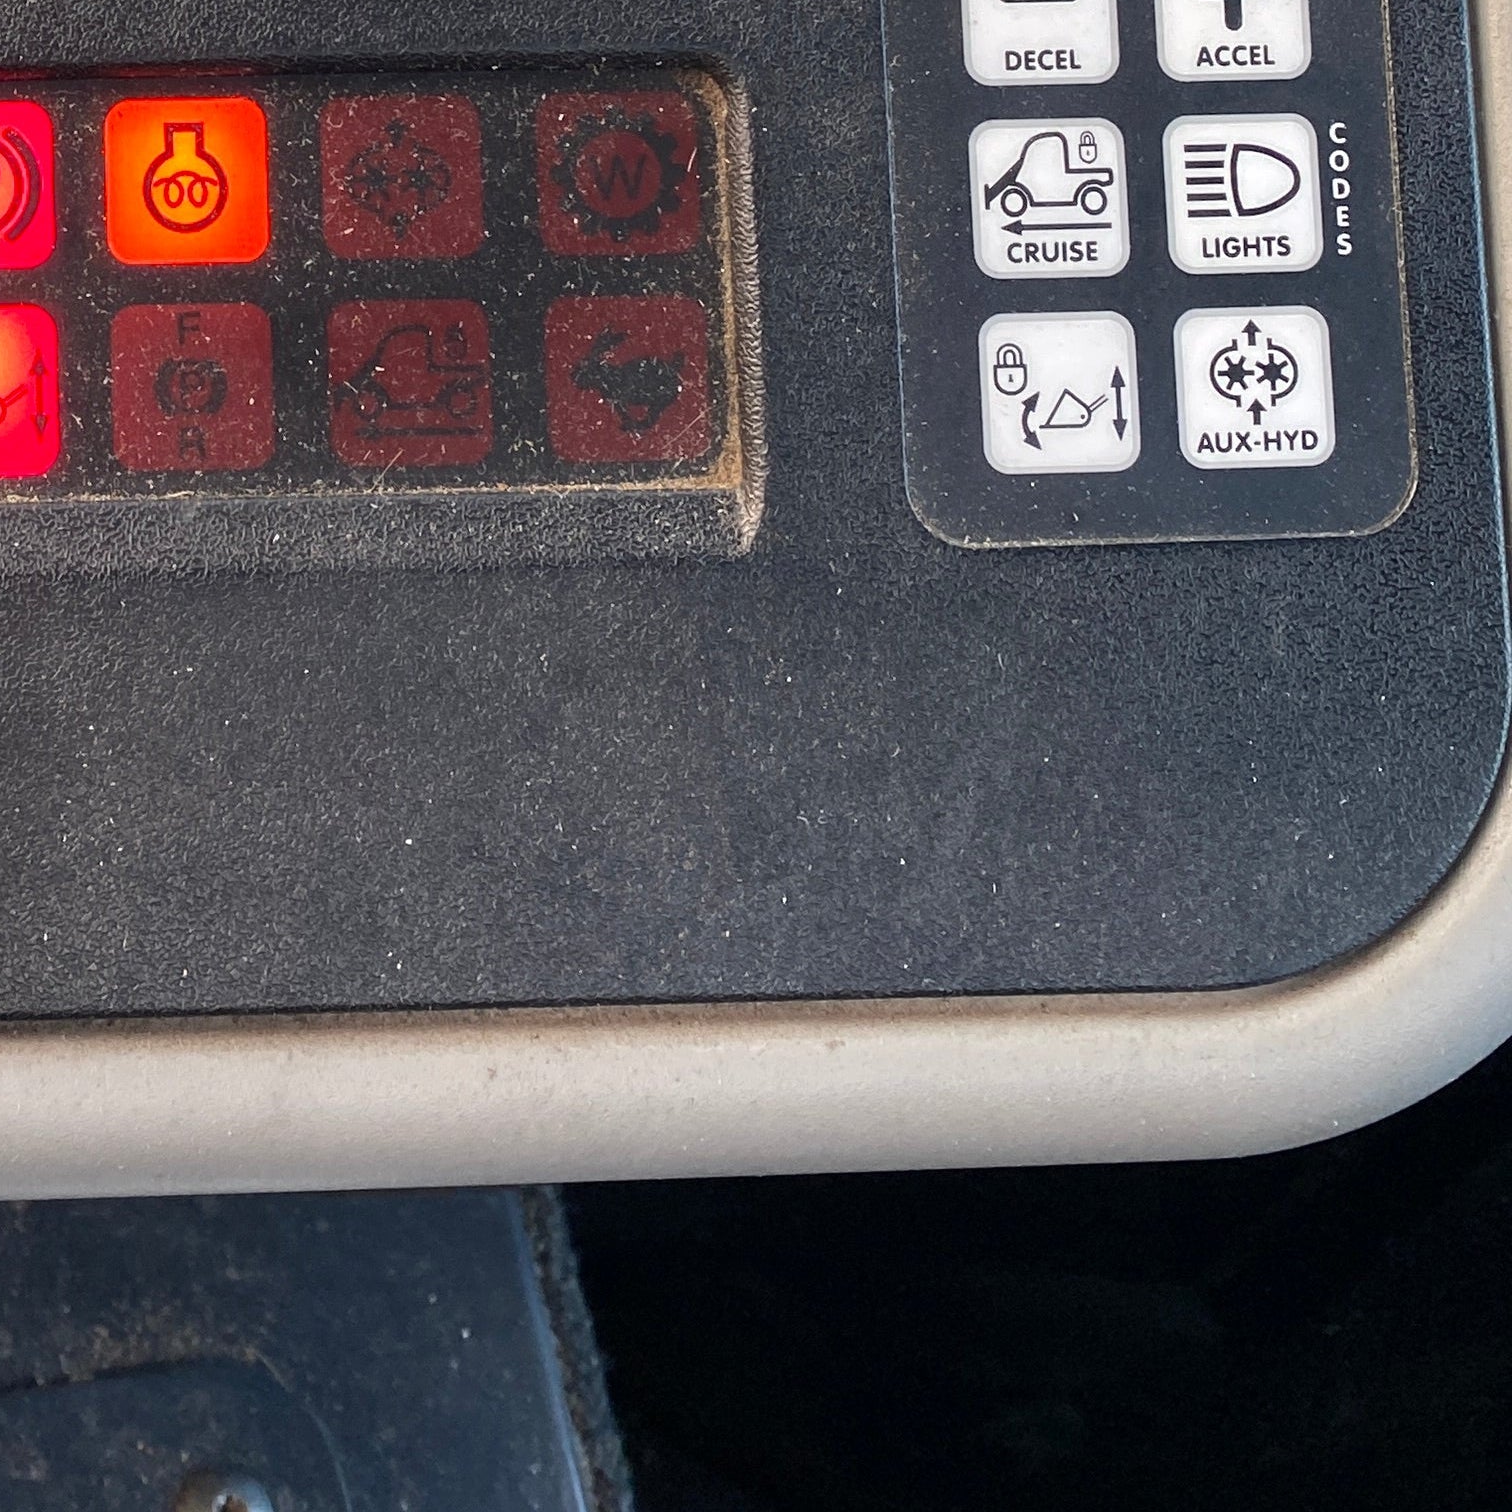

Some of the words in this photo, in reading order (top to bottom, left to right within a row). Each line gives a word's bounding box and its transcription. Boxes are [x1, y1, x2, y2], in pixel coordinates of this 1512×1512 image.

[1004, 49, 1082, 72] DECEL
[1196, 44, 1276, 68] ACCEL
[1328, 121, 1354, 257] CODES
[1006, 240, 1099, 263] CRUISE
[1201, 235, 1292, 258] LIGHTS
[1196, 430, 1319, 454] AUX-HYD
